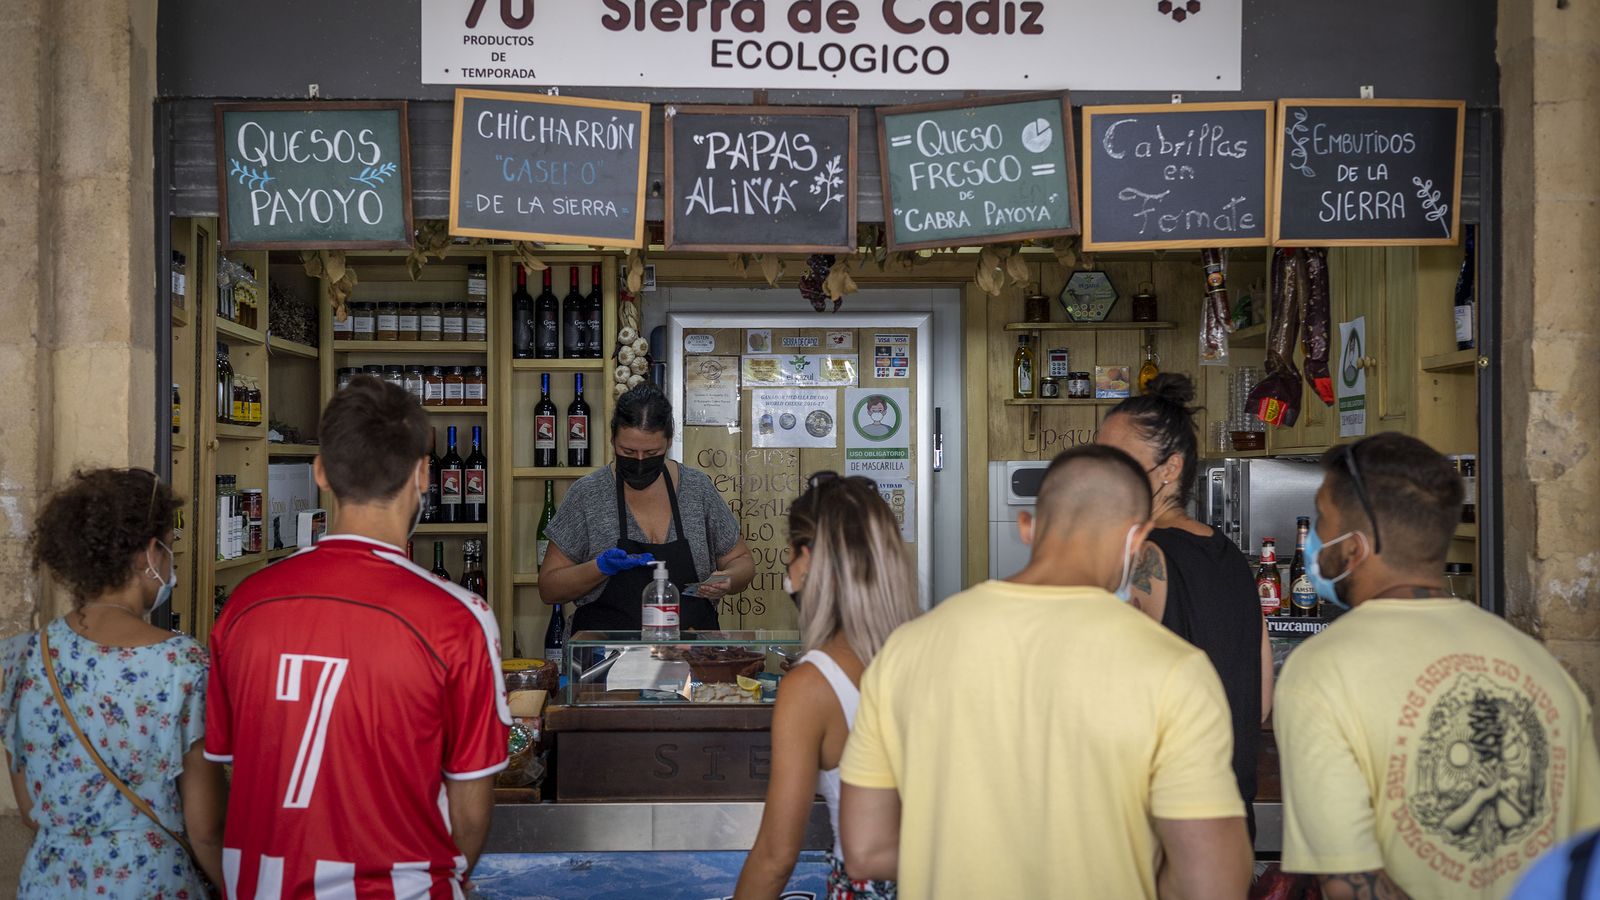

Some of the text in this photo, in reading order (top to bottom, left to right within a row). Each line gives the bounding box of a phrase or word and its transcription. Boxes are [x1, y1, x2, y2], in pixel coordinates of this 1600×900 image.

[601, 0, 765, 32] Sierra
[787, 0, 859, 33] de
[463, 35, 534, 46] PRODUCTOS
[491, 52, 506, 62] DE
[710, 39, 950, 75] ECOLOGICO
[461, 68, 536, 79] TEMPORADA
[237, 121, 381, 167] QUESOS
[916, 119, 1003, 157] QUESO
[1102, 118, 1248, 159] Cabrillas
[909, 154, 1022, 191] FRESCO
[1163, 164, 1196, 181] en
[1338, 163, 1388, 182] DE LA
[250, 187, 383, 226] PAYOYO
[476, 193, 618, 217] DE LA SIERRA
[959, 189, 975, 200] DE
[1319, 190, 1406, 222] SIERRA
[850, 462, 904, 471] DE MASCARILLA
[276, 654, 349, 808] 7
